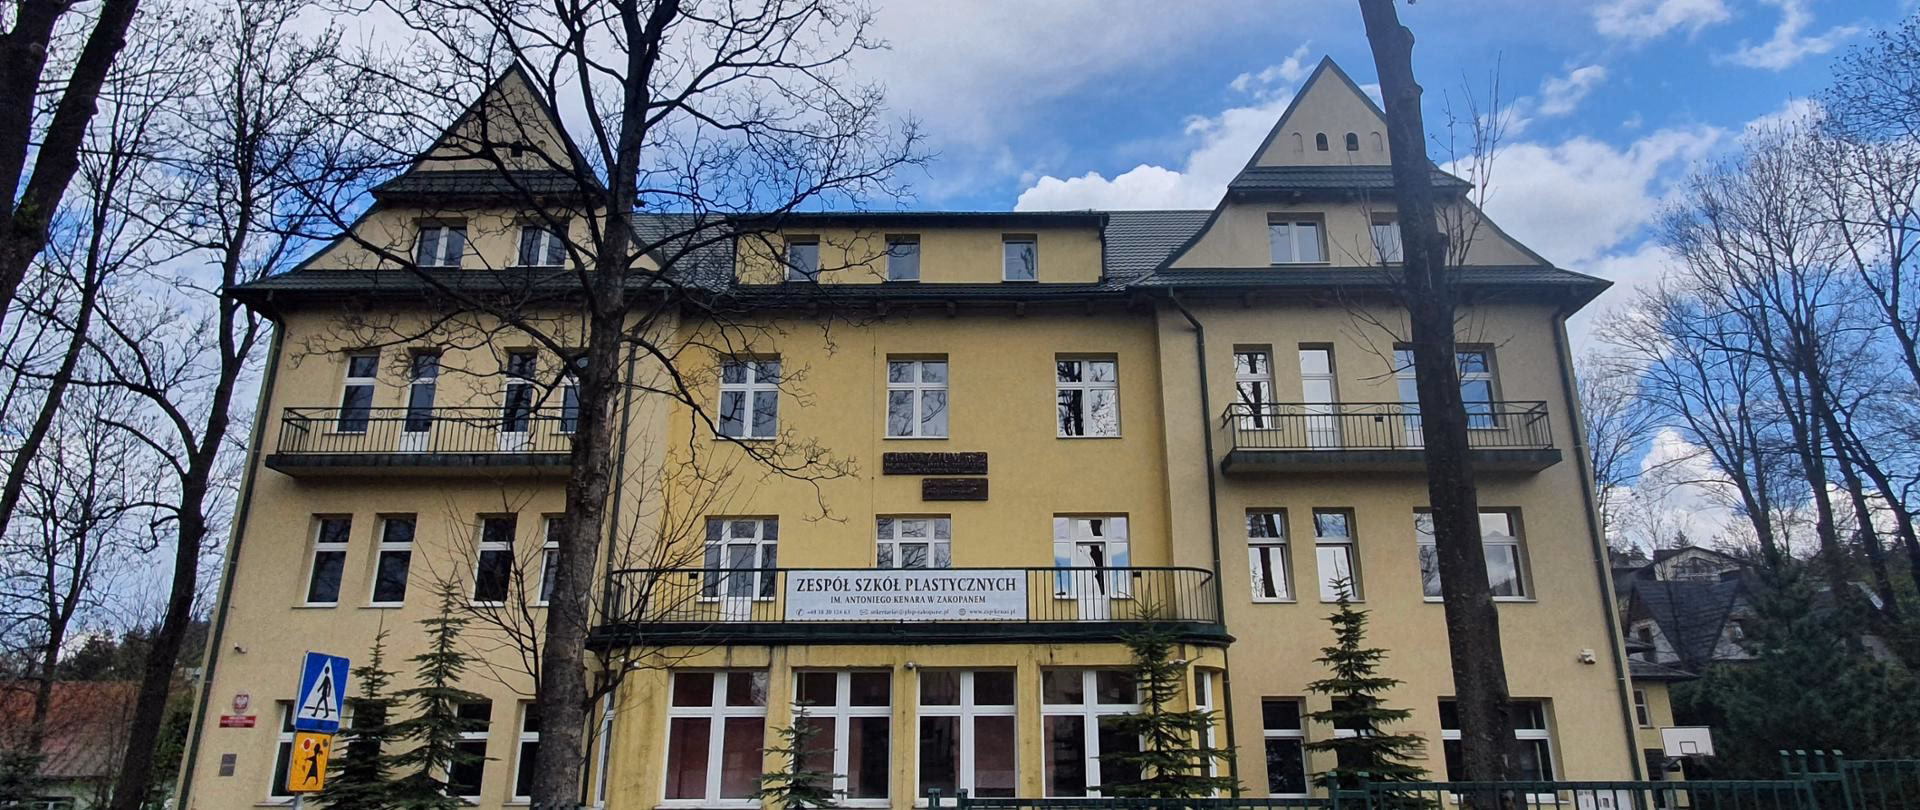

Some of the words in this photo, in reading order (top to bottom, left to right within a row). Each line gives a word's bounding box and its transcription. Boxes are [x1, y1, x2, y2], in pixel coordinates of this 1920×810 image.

[796, 576, 851, 592] ZESPÓŁ
[855, 576, 901, 592] SZKÓŁ
[905, 577, 1016, 592] PLASTYCZNYCH
[844, 595, 892, 604] ANTONIEGO
[893, 595, 926, 604] KENARA
[926, 595, 935, 604] W
[936, 595, 986, 604] ZAKOPANEM
